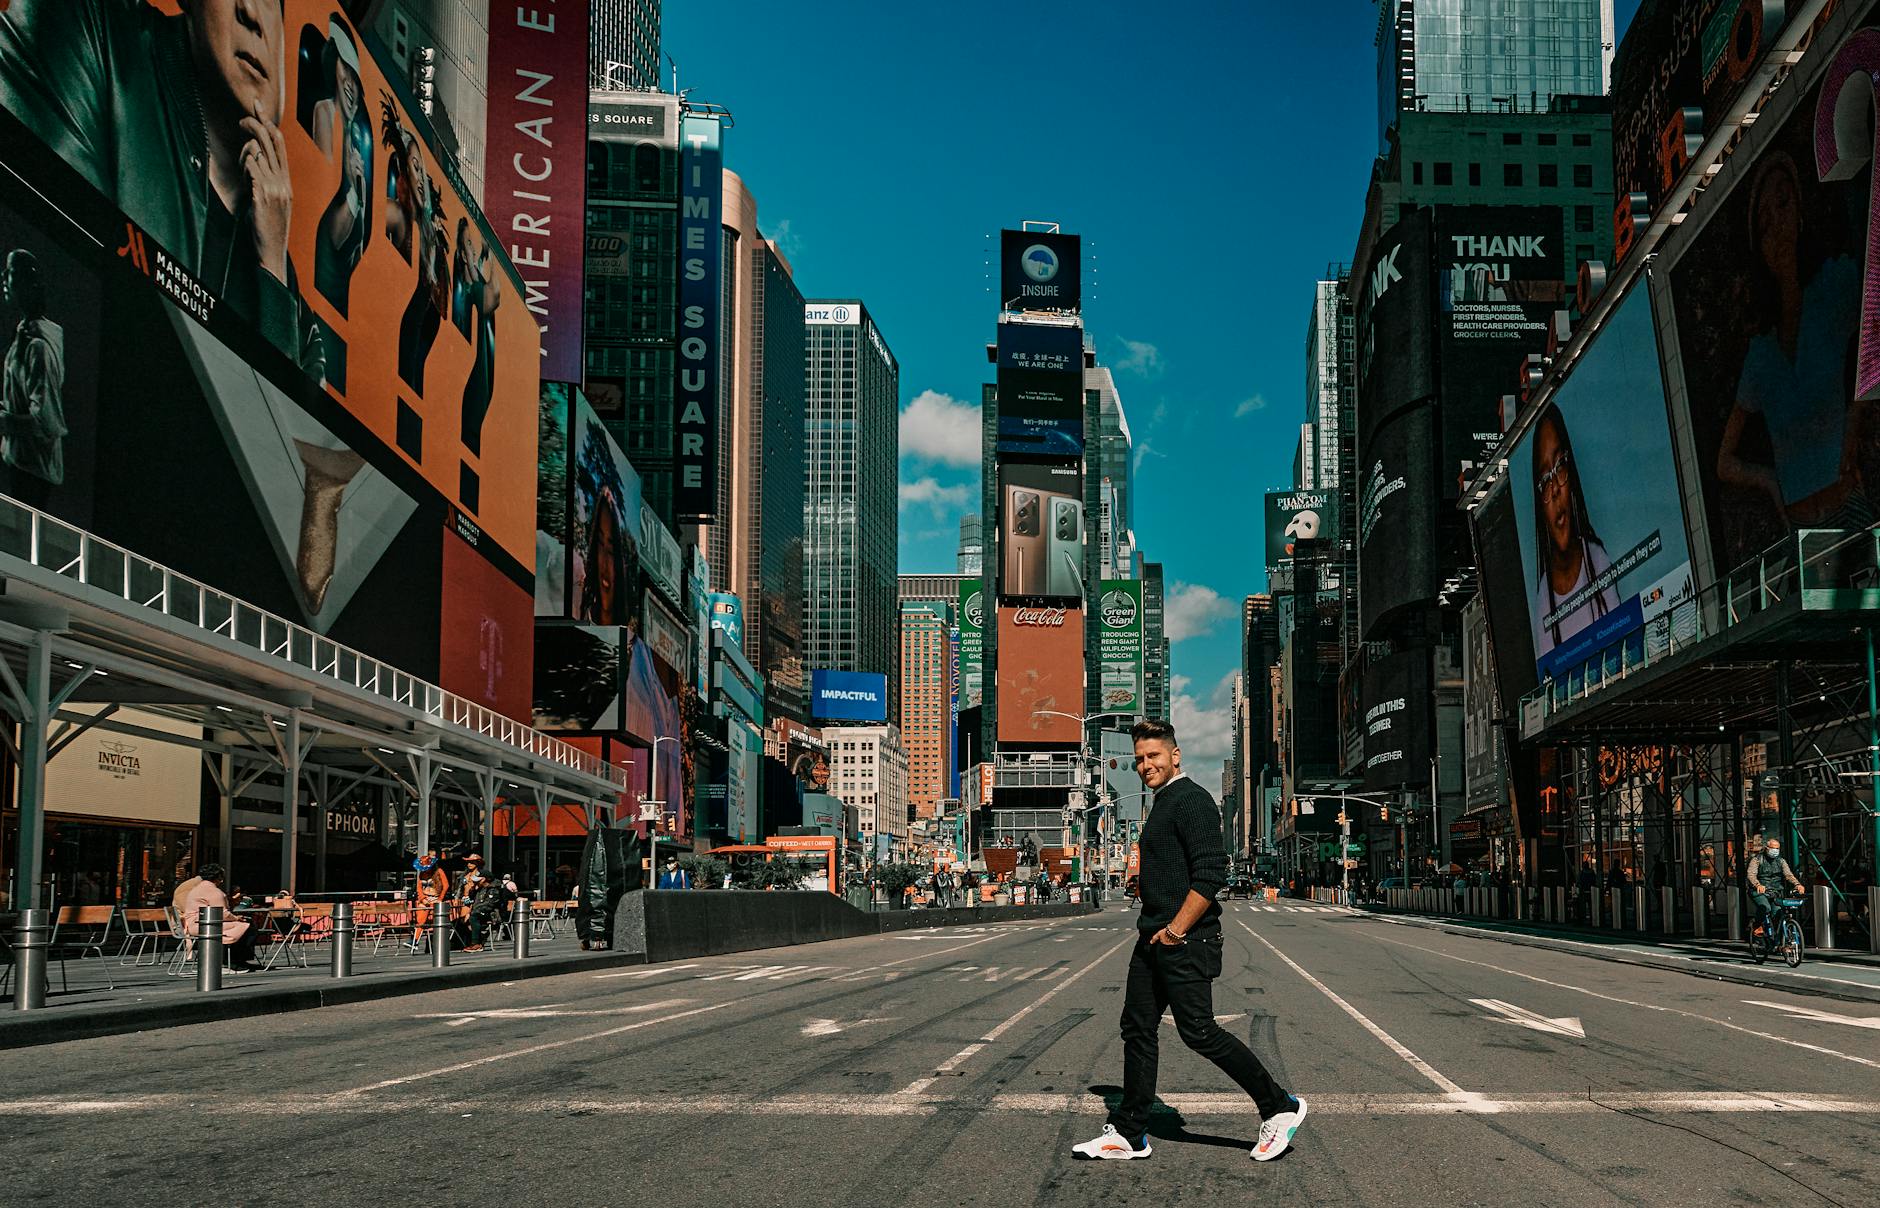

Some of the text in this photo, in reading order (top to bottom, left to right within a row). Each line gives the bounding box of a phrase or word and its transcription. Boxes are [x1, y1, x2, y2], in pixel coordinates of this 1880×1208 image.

[604, 114, 653, 125] SQUARE
[512, 69, 555, 356] MERICAN
[683, 134, 710, 281] TIMES
[1451, 235, 1547, 258] THANK
[156, 250, 216, 310] MARRIOTT
[156, 269, 209, 321] MARQUIS
[1021, 284, 1060, 297] INSURE
[1453, 304, 1523, 312] DOCTORS, NURSES,
[1453, 313, 1527, 322] FIRST RESPONDERS,
[1453, 322, 1548, 331] HEALTH CARE PROVIDERS,
[1453, 331, 1521, 340] GROCERY CLERKS,
[1018, 360, 1030, 368] WE
[1047, 362, 1064, 370] ONE
[680, 305, 707, 488] SQUARE
[1472, 432, 1499, 441] WE'RE
[1051, 468, 1078, 476] SAMSUNG
[1277, 494, 1328, 508] PHANTOM
[1103, 607, 1135, 616] Green
[1106, 615, 1135, 626] Giant
[821, 689, 878, 702] IMPACTFUL
[1385, 697, 1406, 712] THIS
[98, 751, 141, 769] INVICTA
[326, 811, 376, 834] EPHORA
